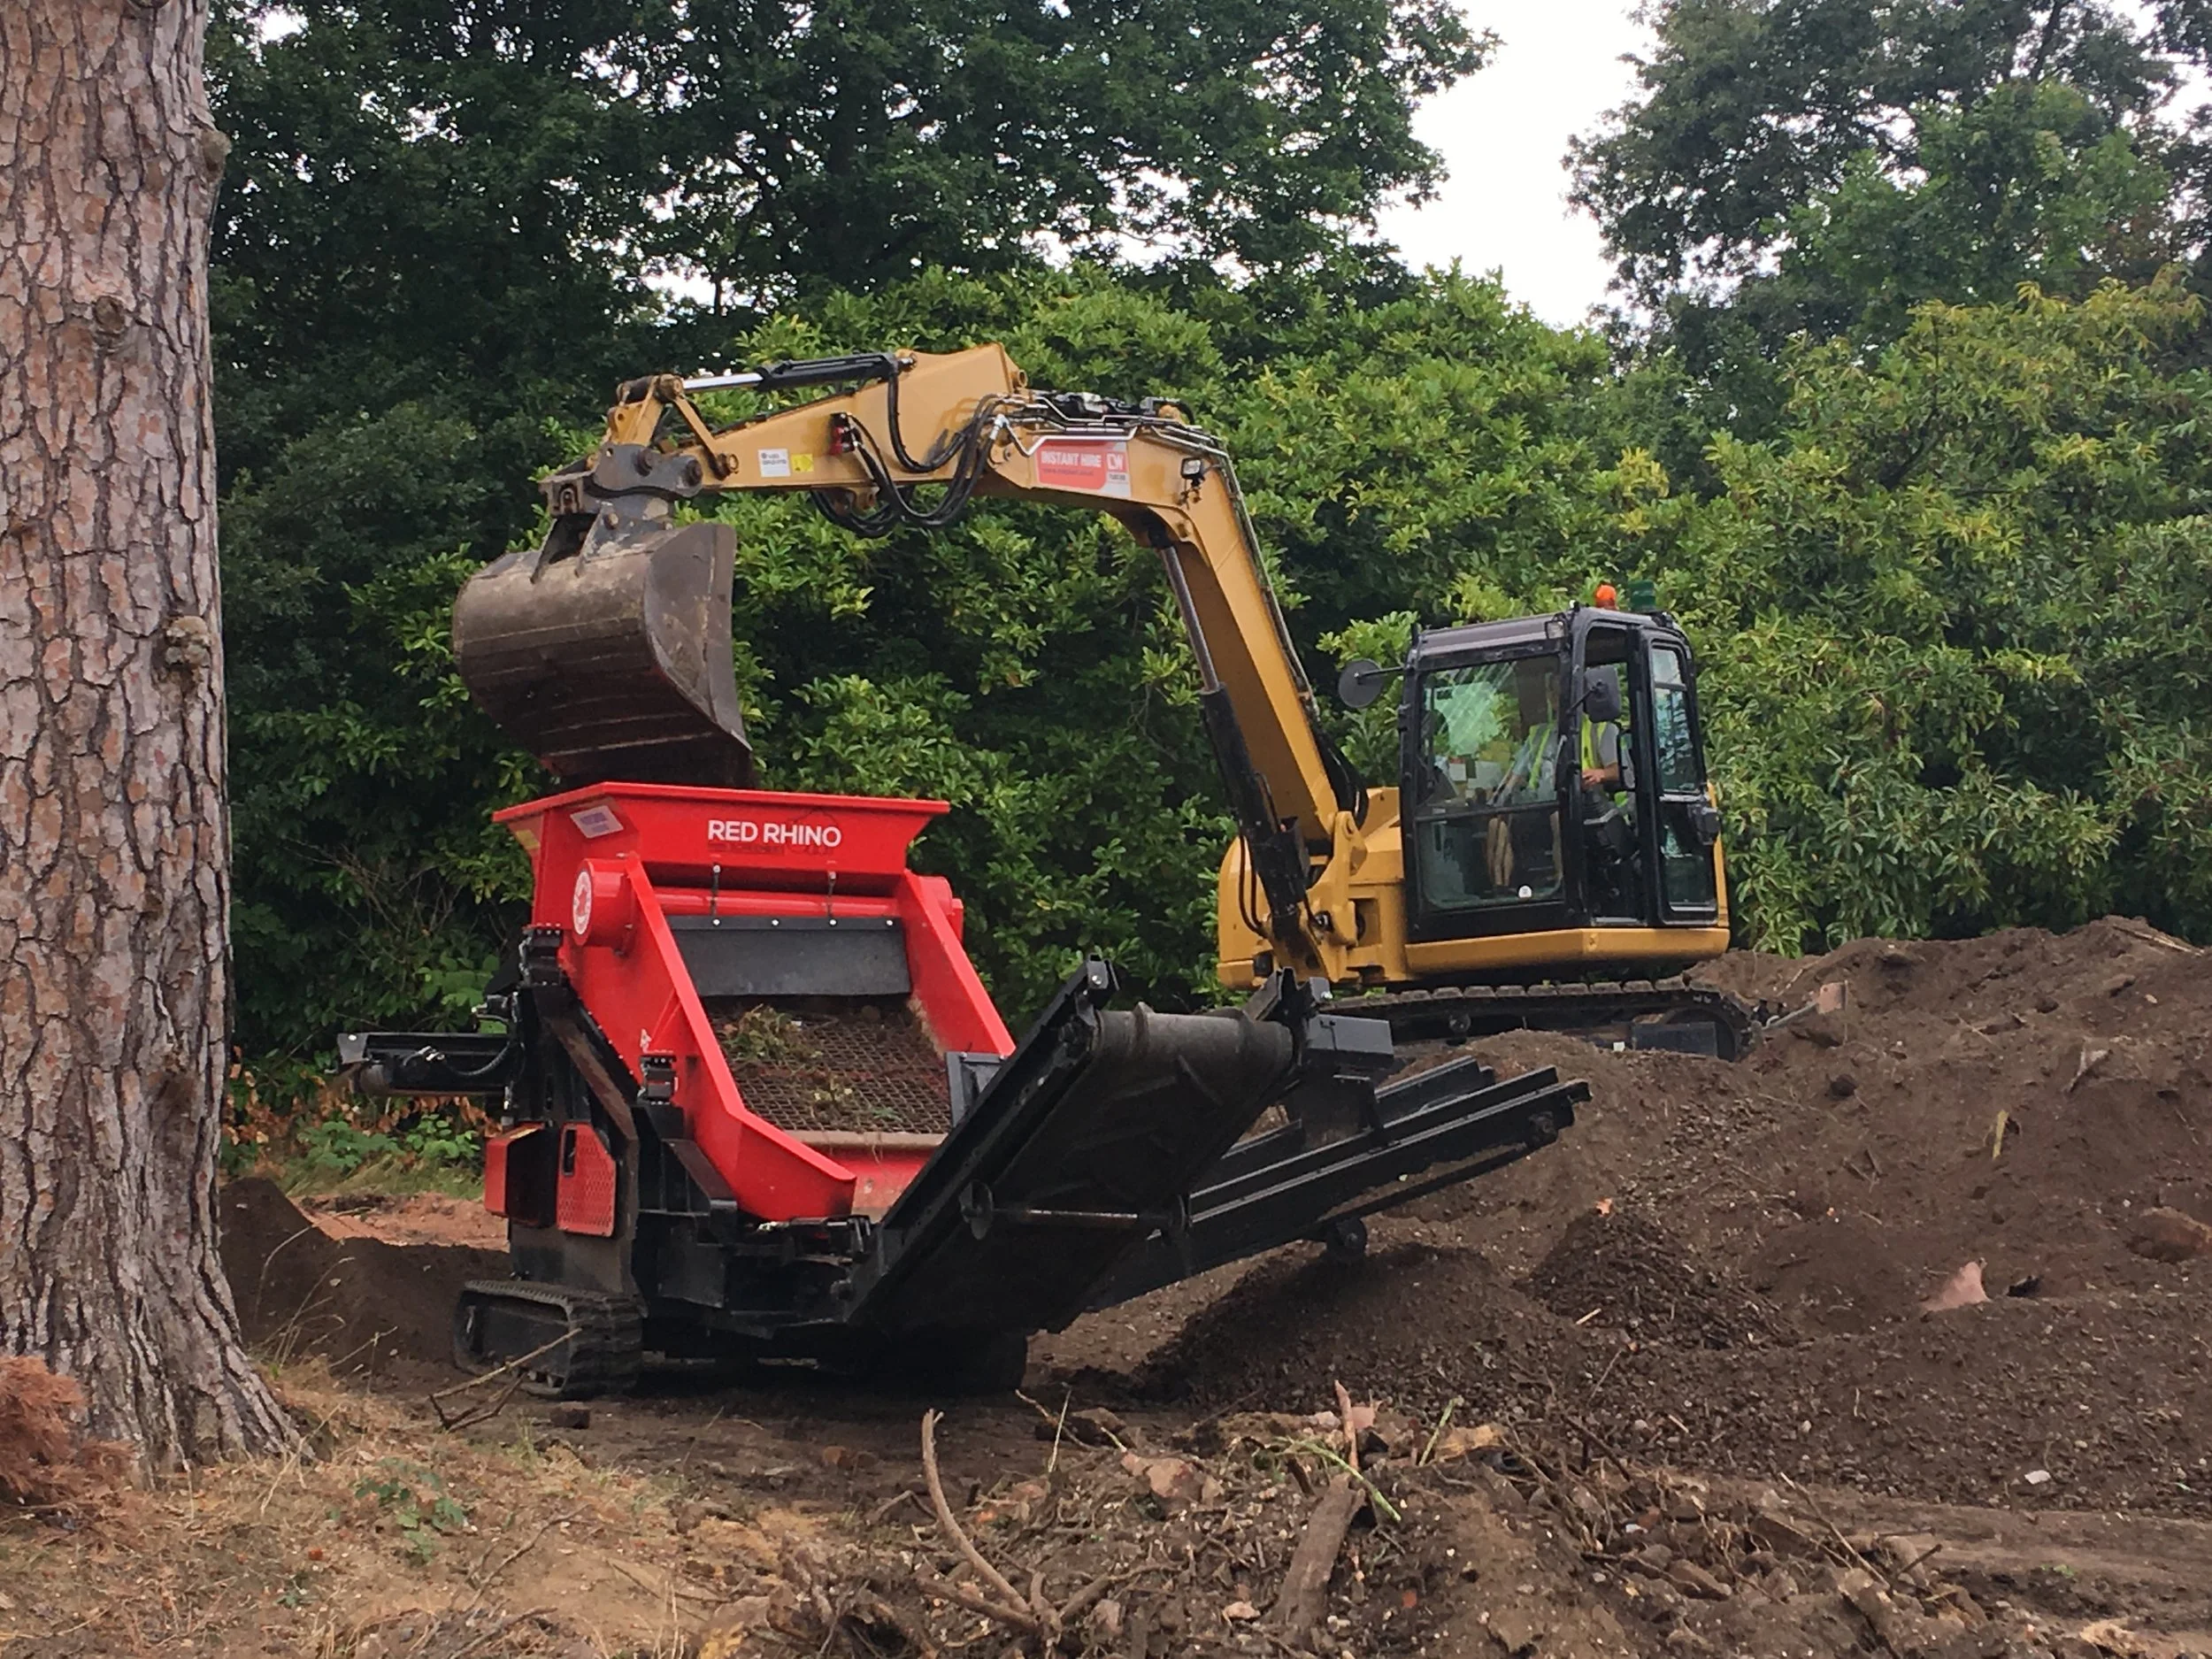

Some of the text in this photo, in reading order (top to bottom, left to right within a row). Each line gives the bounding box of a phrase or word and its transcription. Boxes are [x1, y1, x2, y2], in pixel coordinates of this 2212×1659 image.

[1041, 450, 1102, 468] INSTANT HIRE
[707, 819, 841, 848] RED RHINO
